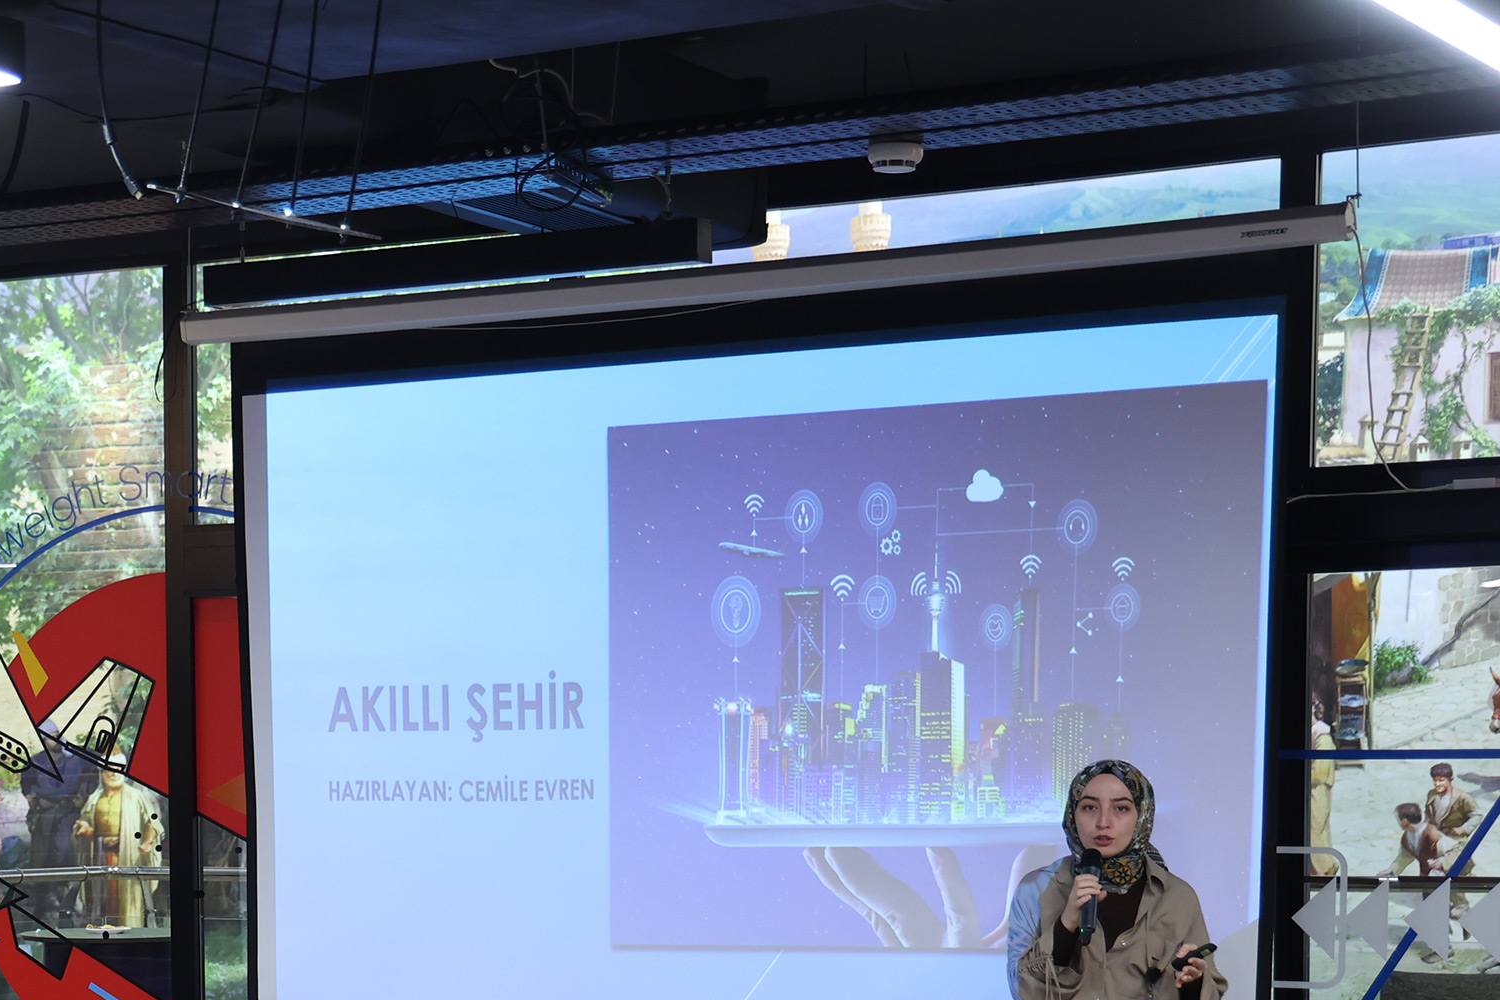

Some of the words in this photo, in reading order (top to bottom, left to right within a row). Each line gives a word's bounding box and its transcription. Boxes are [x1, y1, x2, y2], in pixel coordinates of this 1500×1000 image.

[118, 464, 234, 505] Smart
[328, 684, 450, 733] AKILLI
[466, 670, 585, 743] ŞEHİR
[328, 779, 453, 802] HAZIRLAYAN:
[458, 774, 529, 803] CEMİLE
[534, 778, 595, 801] EVREN
